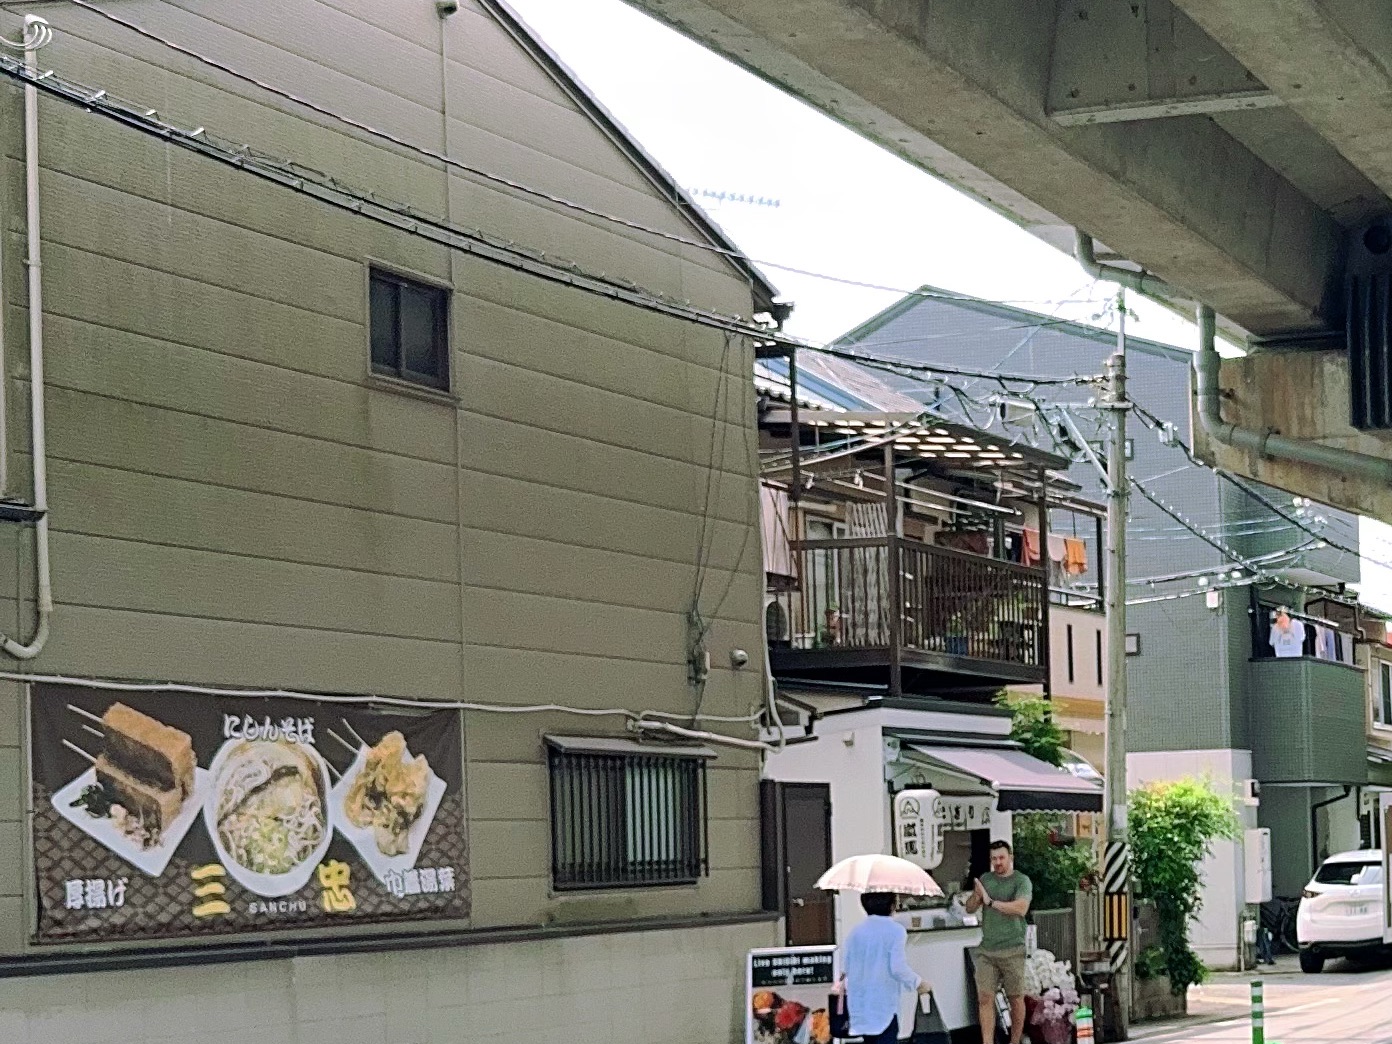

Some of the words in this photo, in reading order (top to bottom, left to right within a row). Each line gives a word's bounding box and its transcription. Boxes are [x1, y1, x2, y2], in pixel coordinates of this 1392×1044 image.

[64, 877, 128, 910] 厚揚げ
[248, 900, 308, 915] SANCHU
